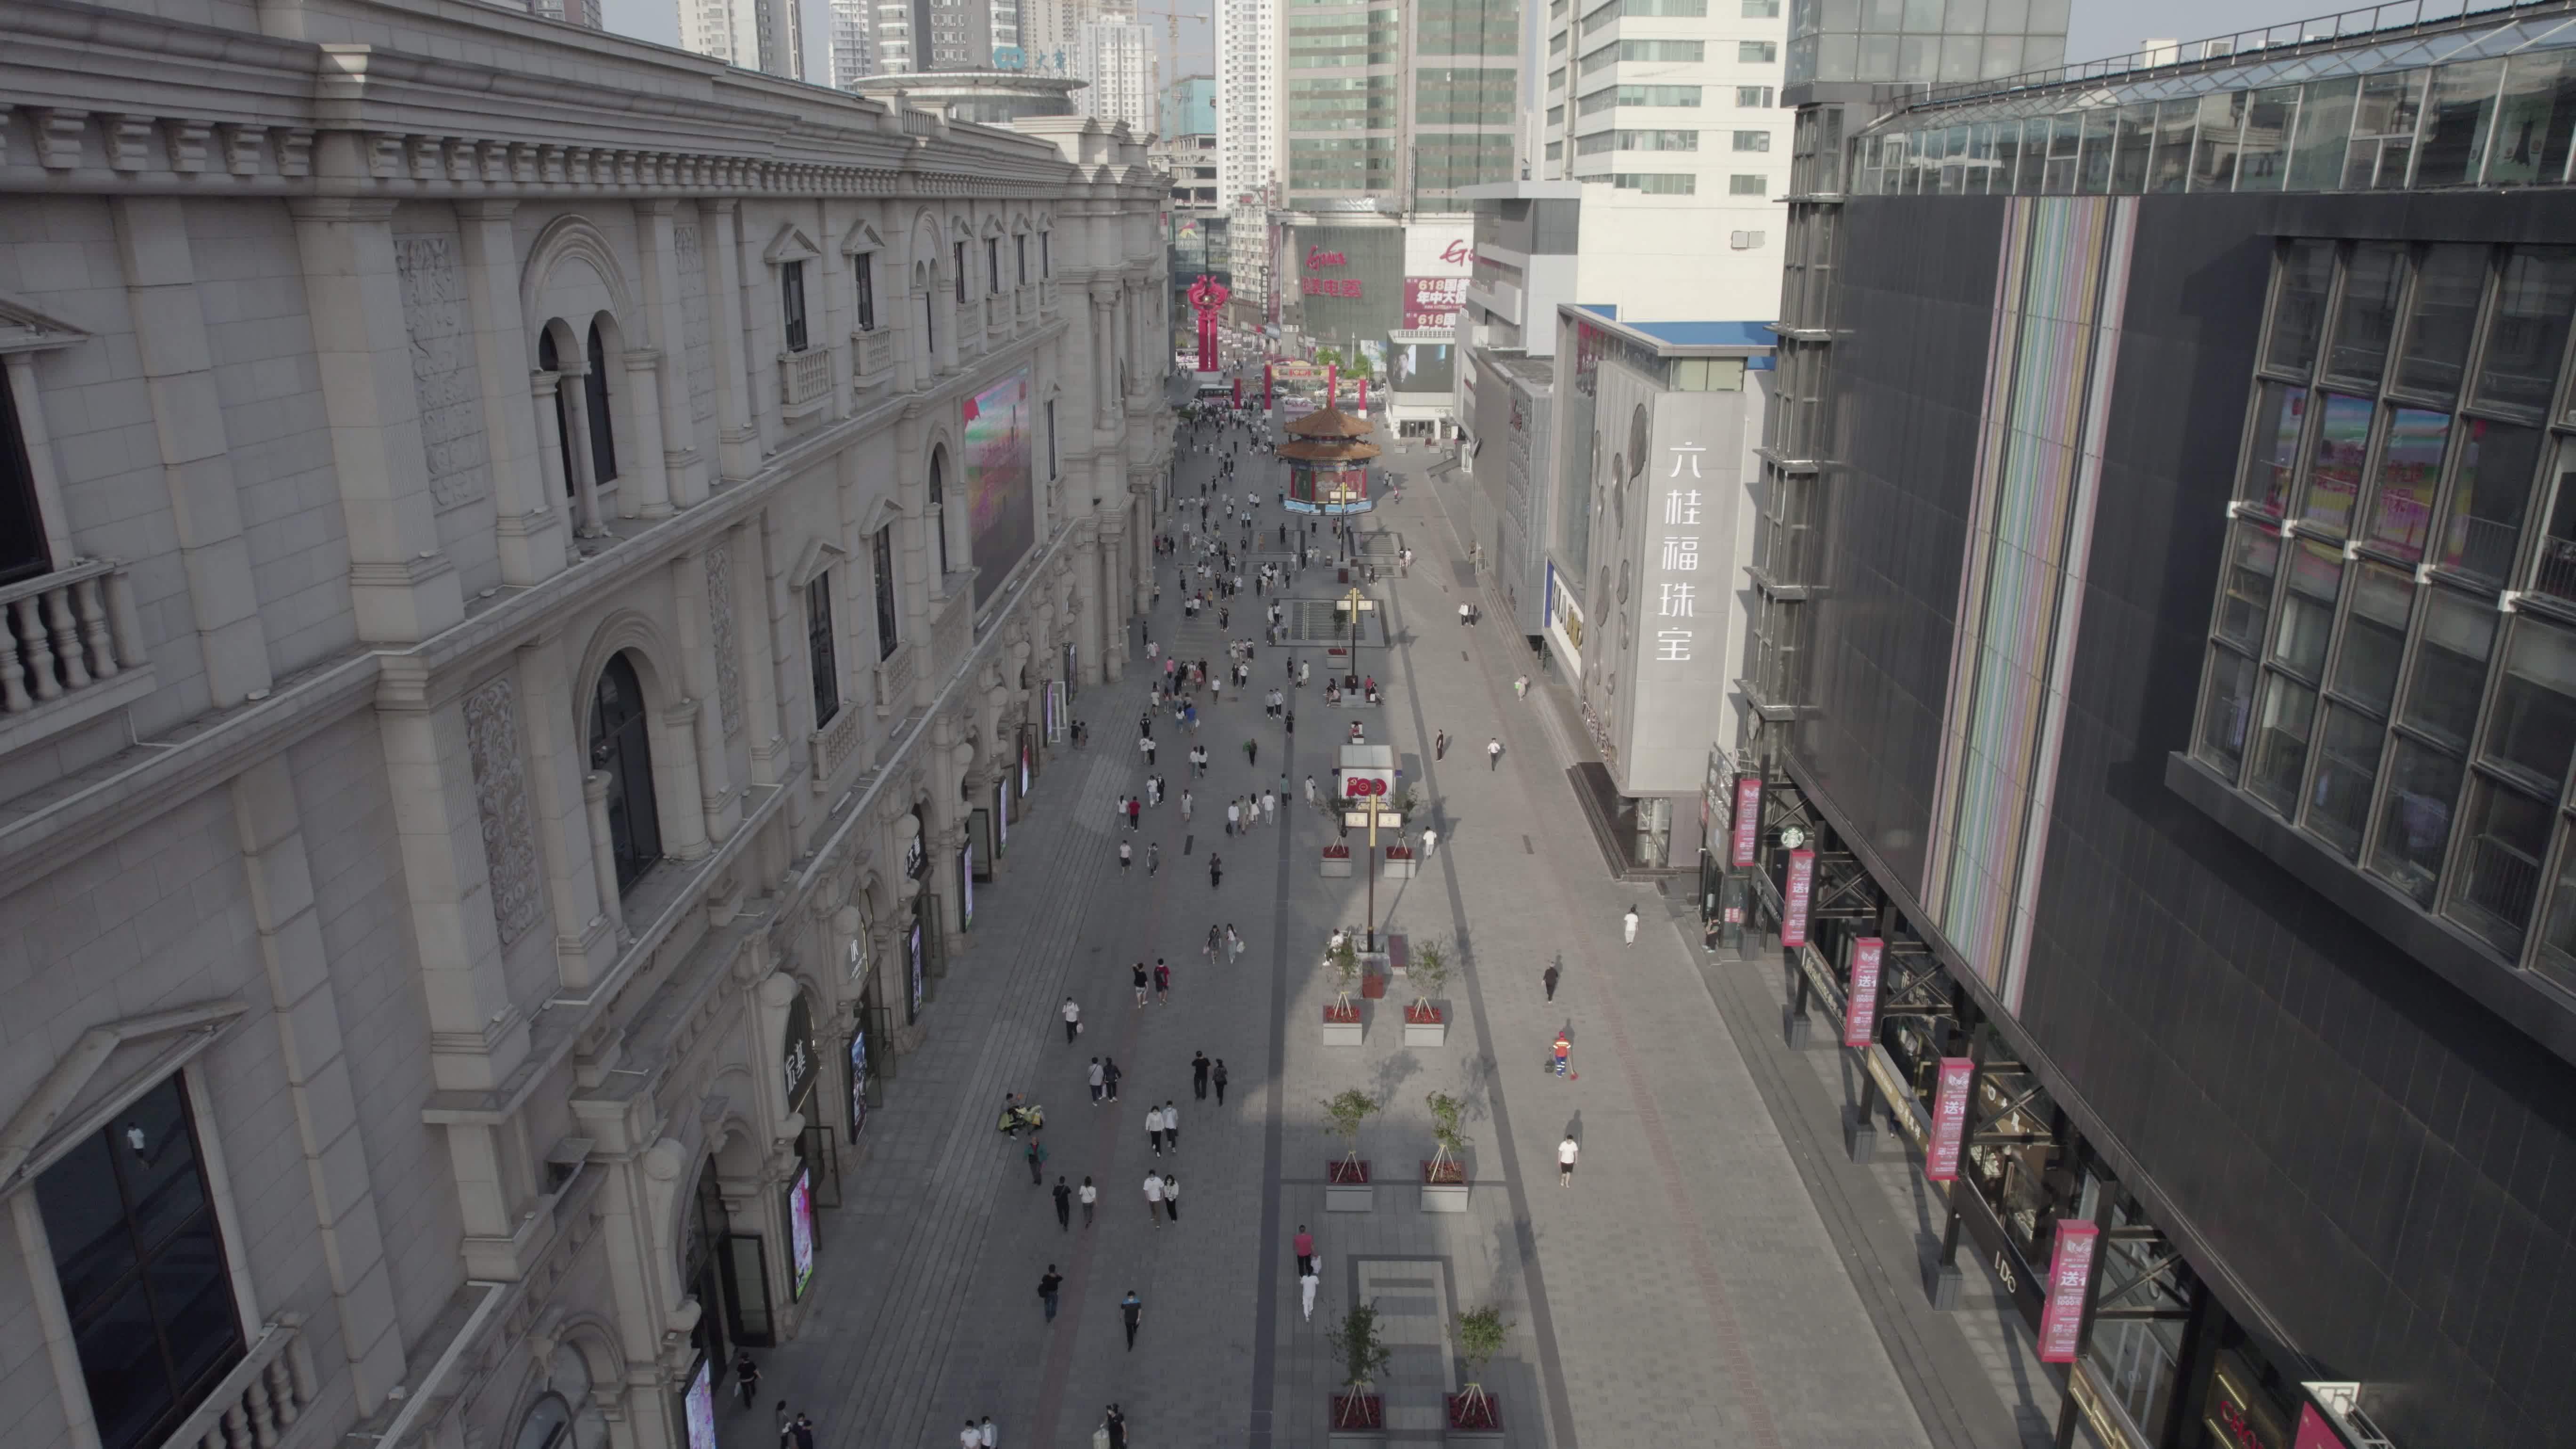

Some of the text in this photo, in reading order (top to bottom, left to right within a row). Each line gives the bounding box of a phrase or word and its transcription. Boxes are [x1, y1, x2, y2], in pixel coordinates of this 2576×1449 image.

[1656, 441, 1707, 661] 六桂福珠宝
